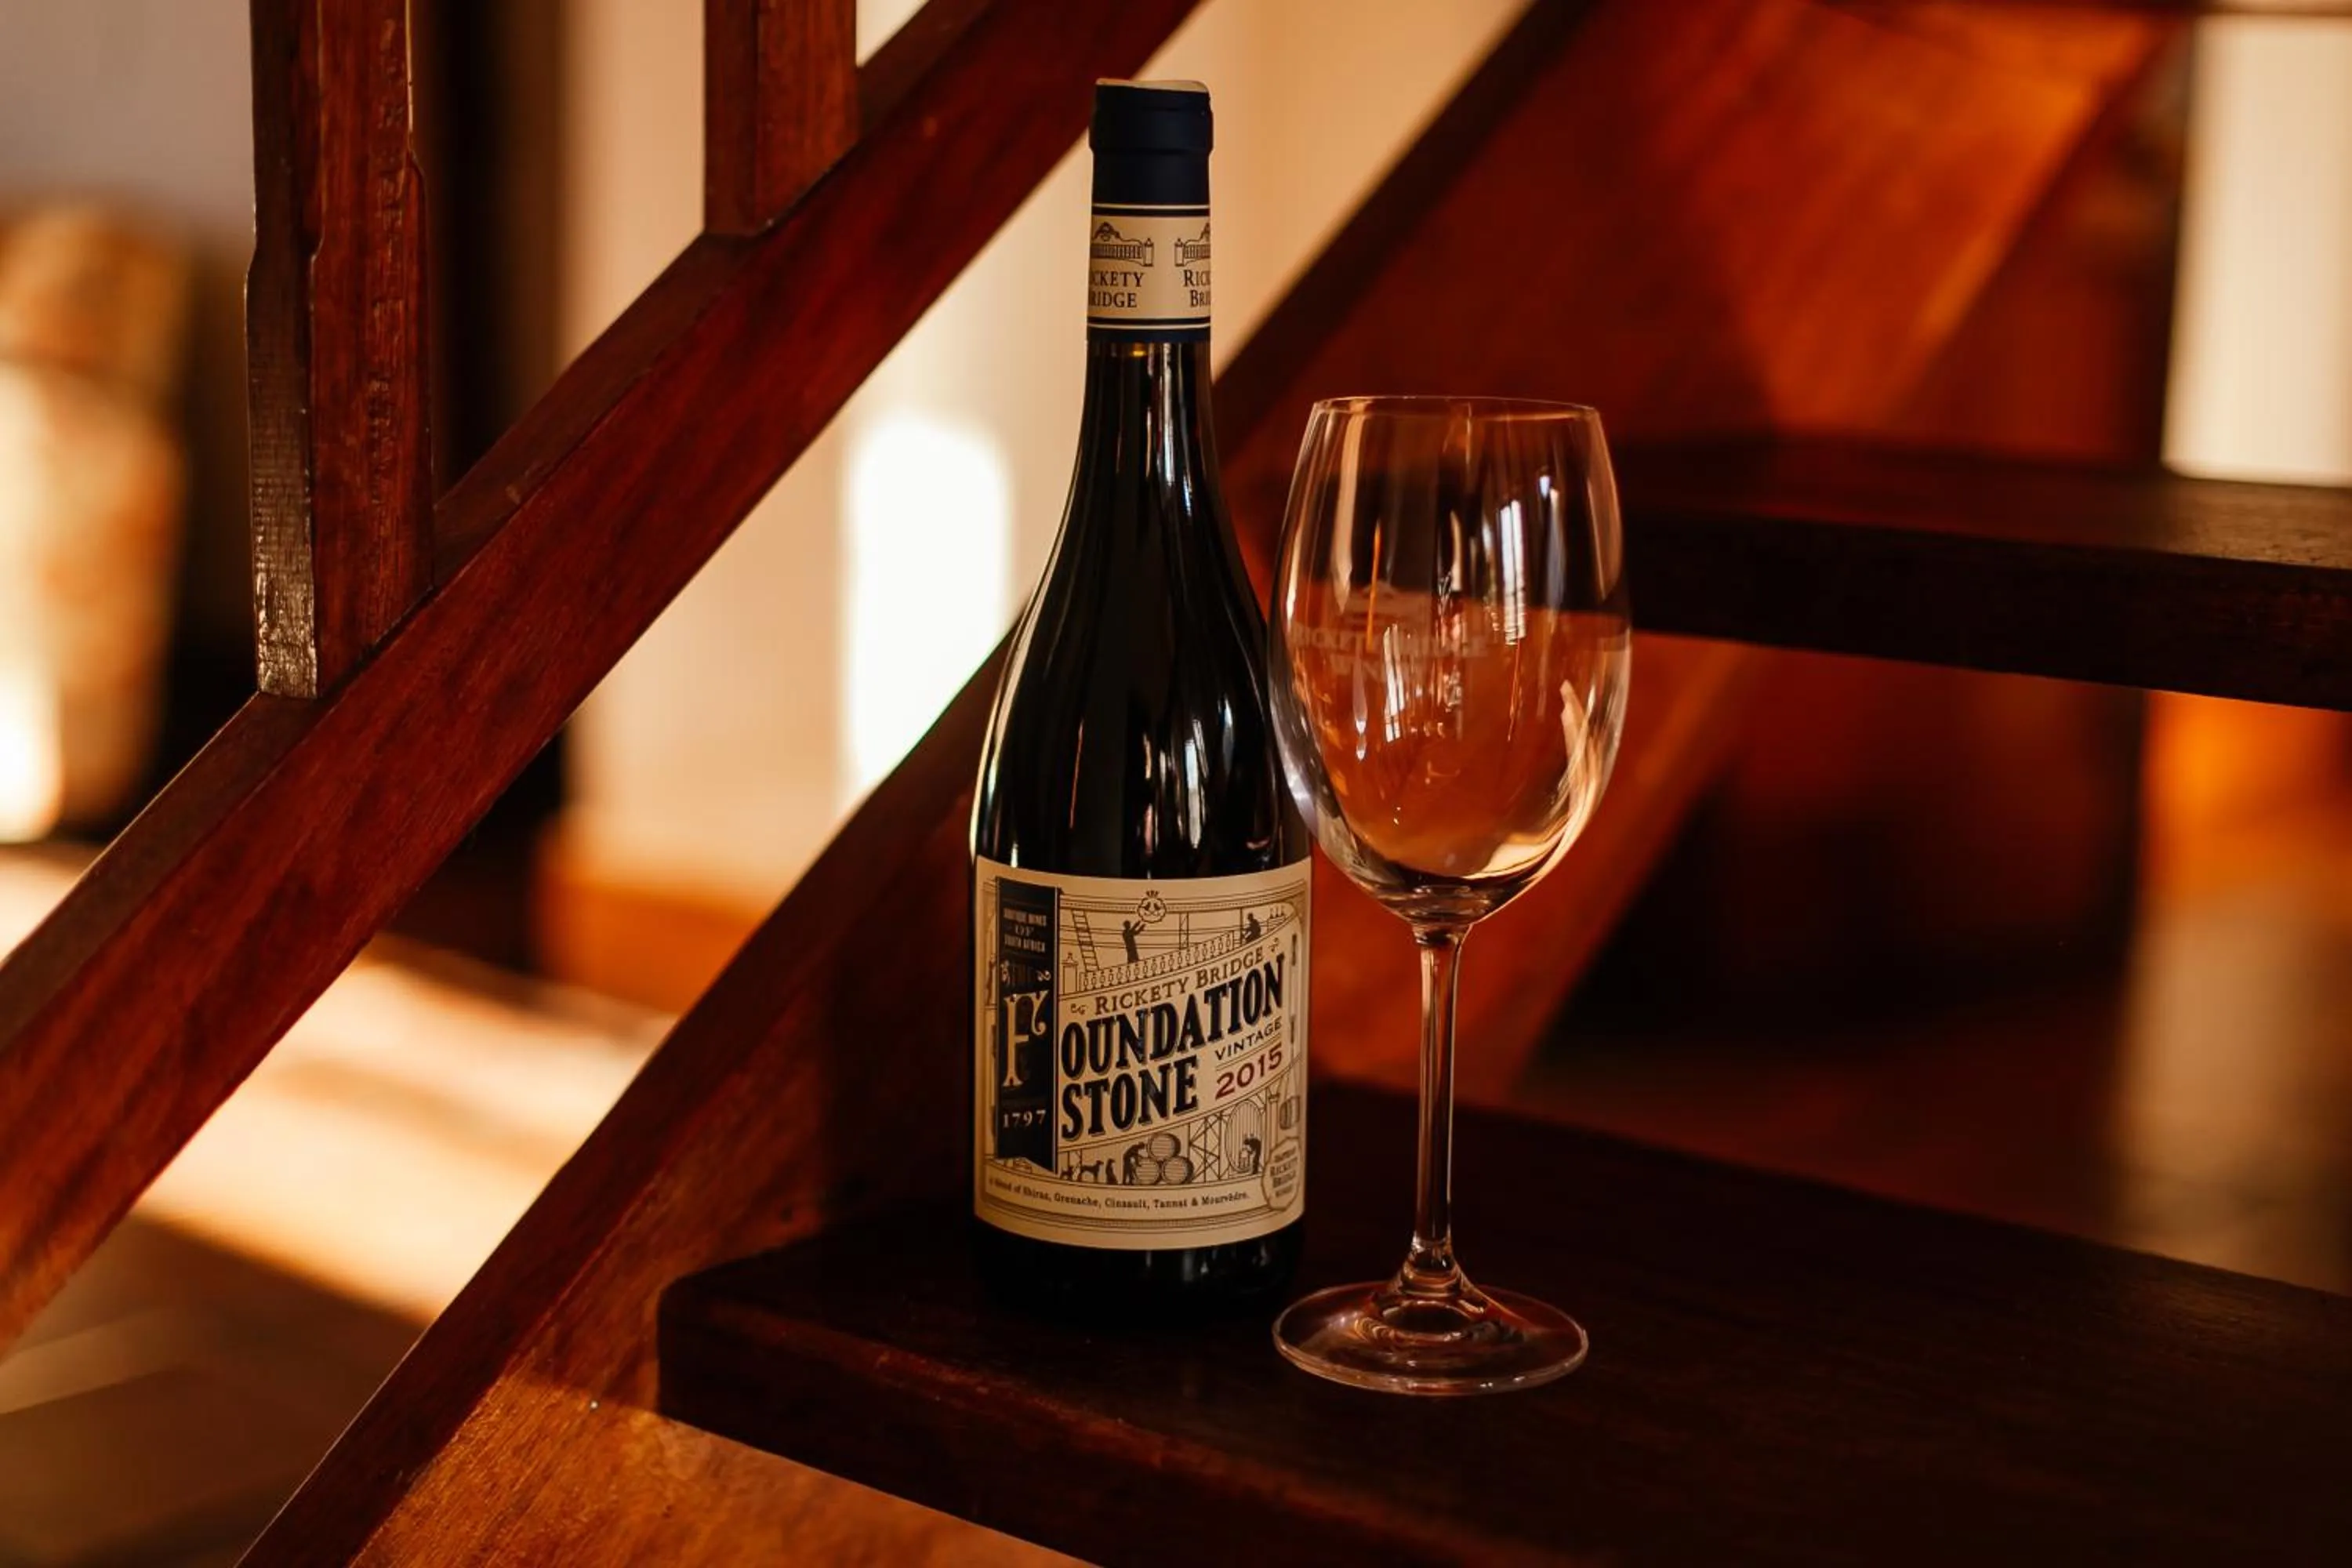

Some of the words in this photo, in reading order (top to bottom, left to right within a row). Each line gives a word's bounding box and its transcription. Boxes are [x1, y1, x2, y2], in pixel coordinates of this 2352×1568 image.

[1089, 290, 1138, 308] RIDGE
[1095, 979, 1190, 1014] RICKETY
[1196, 947, 1263, 989] BRIDGE
[1215, 1017, 1283, 1060] VINTAGE
[1215, 1044, 1283, 1101] 2015
[1002, 1109, 1047, 1129] 1797
[1061, 1055, 1199, 1141] STONE
[1054, 1192, 1102, 1209] Grenache,
[1153, 1198, 1188, 1209] Tannat
[1191, 1197, 1199, 1208] &
